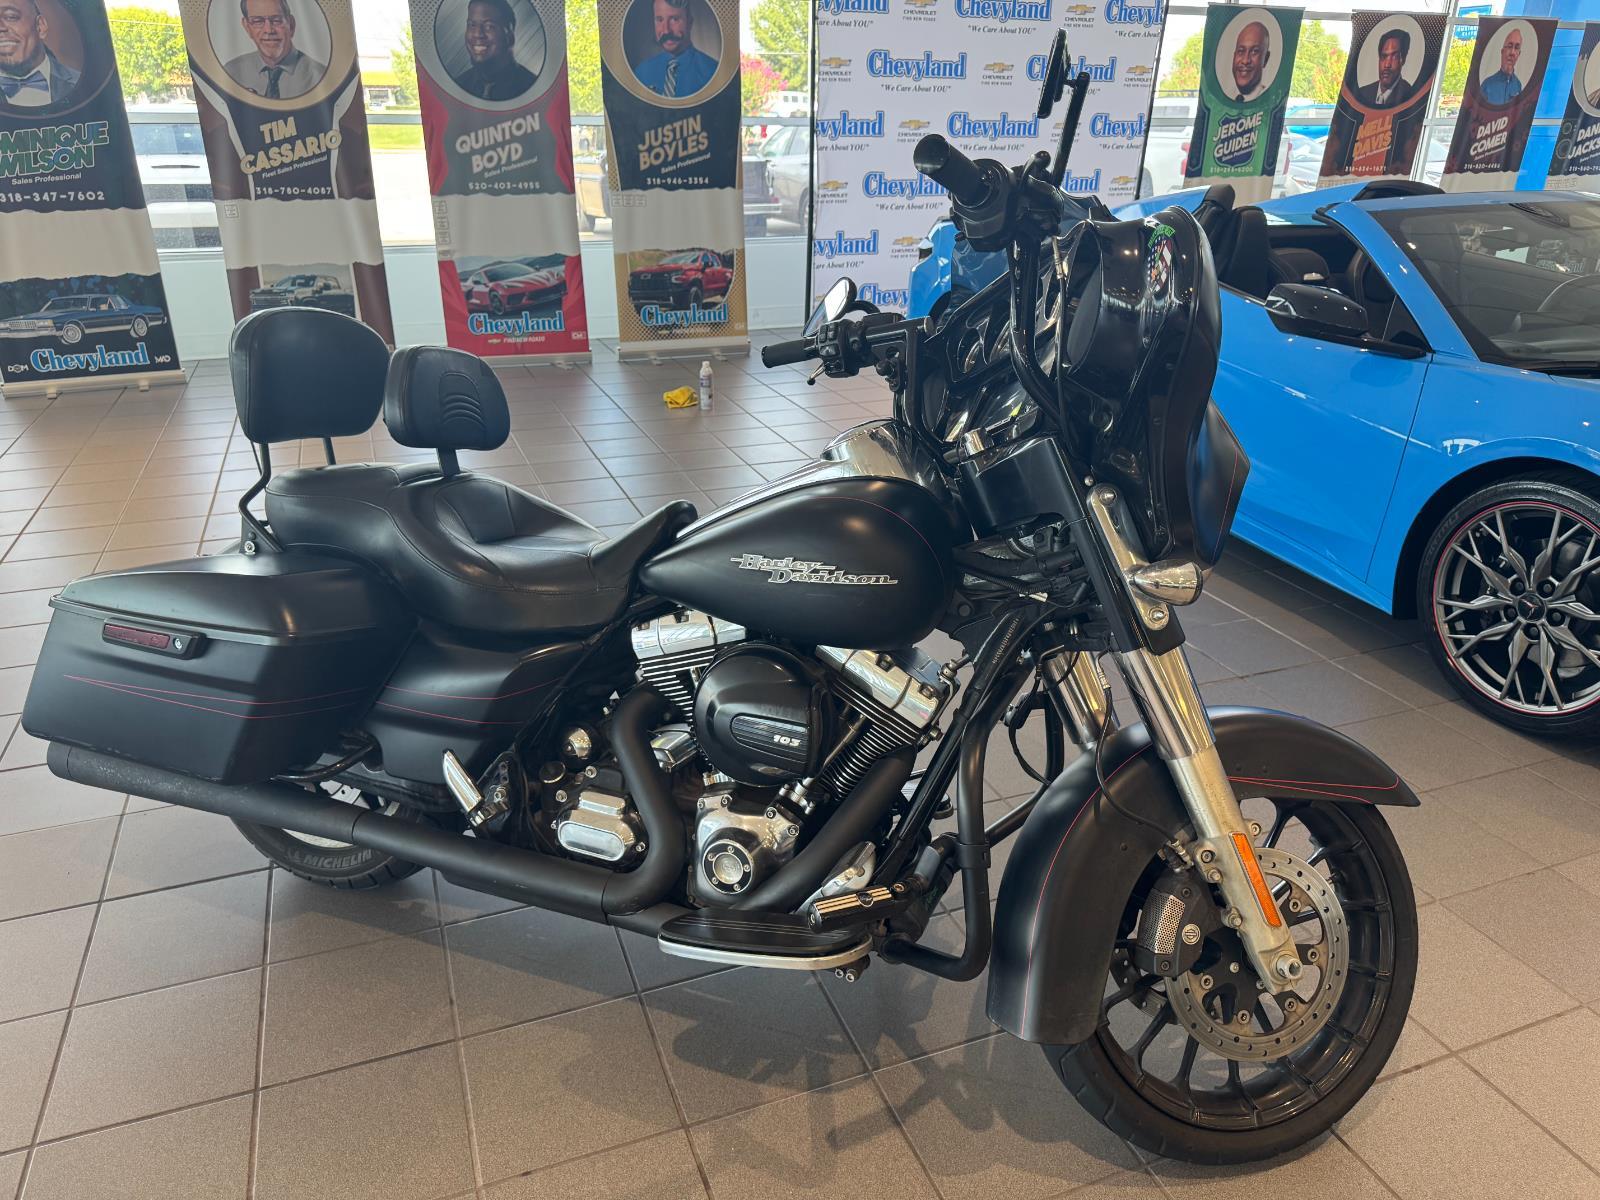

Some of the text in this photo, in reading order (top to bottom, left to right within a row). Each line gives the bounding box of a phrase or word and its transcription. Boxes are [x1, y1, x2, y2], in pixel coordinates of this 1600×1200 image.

[830, 19, 852, 27] About
[954, 0, 1052, 23] Chevyland
[982, 25, 998, 33] Care
[998, 25, 1017, 34] About
[866, 49, 967, 81] Chevyland
[896, 84, 911, 92] Care
[911, 84, 932, 92] About
[260, 116, 298, 144] TIM
[455, 112, 540, 154] QUINTON
[637, 114, 702, 151] JUSTIN
[947, 111, 1040, 141] Chevyland
[1212, 111, 1263, 141] JEROME
[1476, 116, 1509, 139] DAVID
[240, 129, 342, 174] CASSARIO
[639, 131, 709, 171] BOYLES
[988, 143, 1006, 151] About
[1214, 130, 1258, 157] GUIDEN
[1352, 131, 1393, 161] DAVIS
[1469, 131, 1508, 156] COMER
[277, 164, 292, 175] Sales
[293, 154, 328, 170] Professional
[472, 142, 523, 174] BOYD
[677, 152, 711, 168] Professional
[35, 172, 82, 183] Professional
[863, 171, 950, 200] Chevylan
[467, 310, 566, 335] Chevyland
[640, 303, 729, 327] Chevyland
[30, 342, 151, 373] Chevyland
[731, 553, 837, 573] Harley
[767, 567, 898, 585] Davidson
[303, 848, 372, 869] MICHELIN
